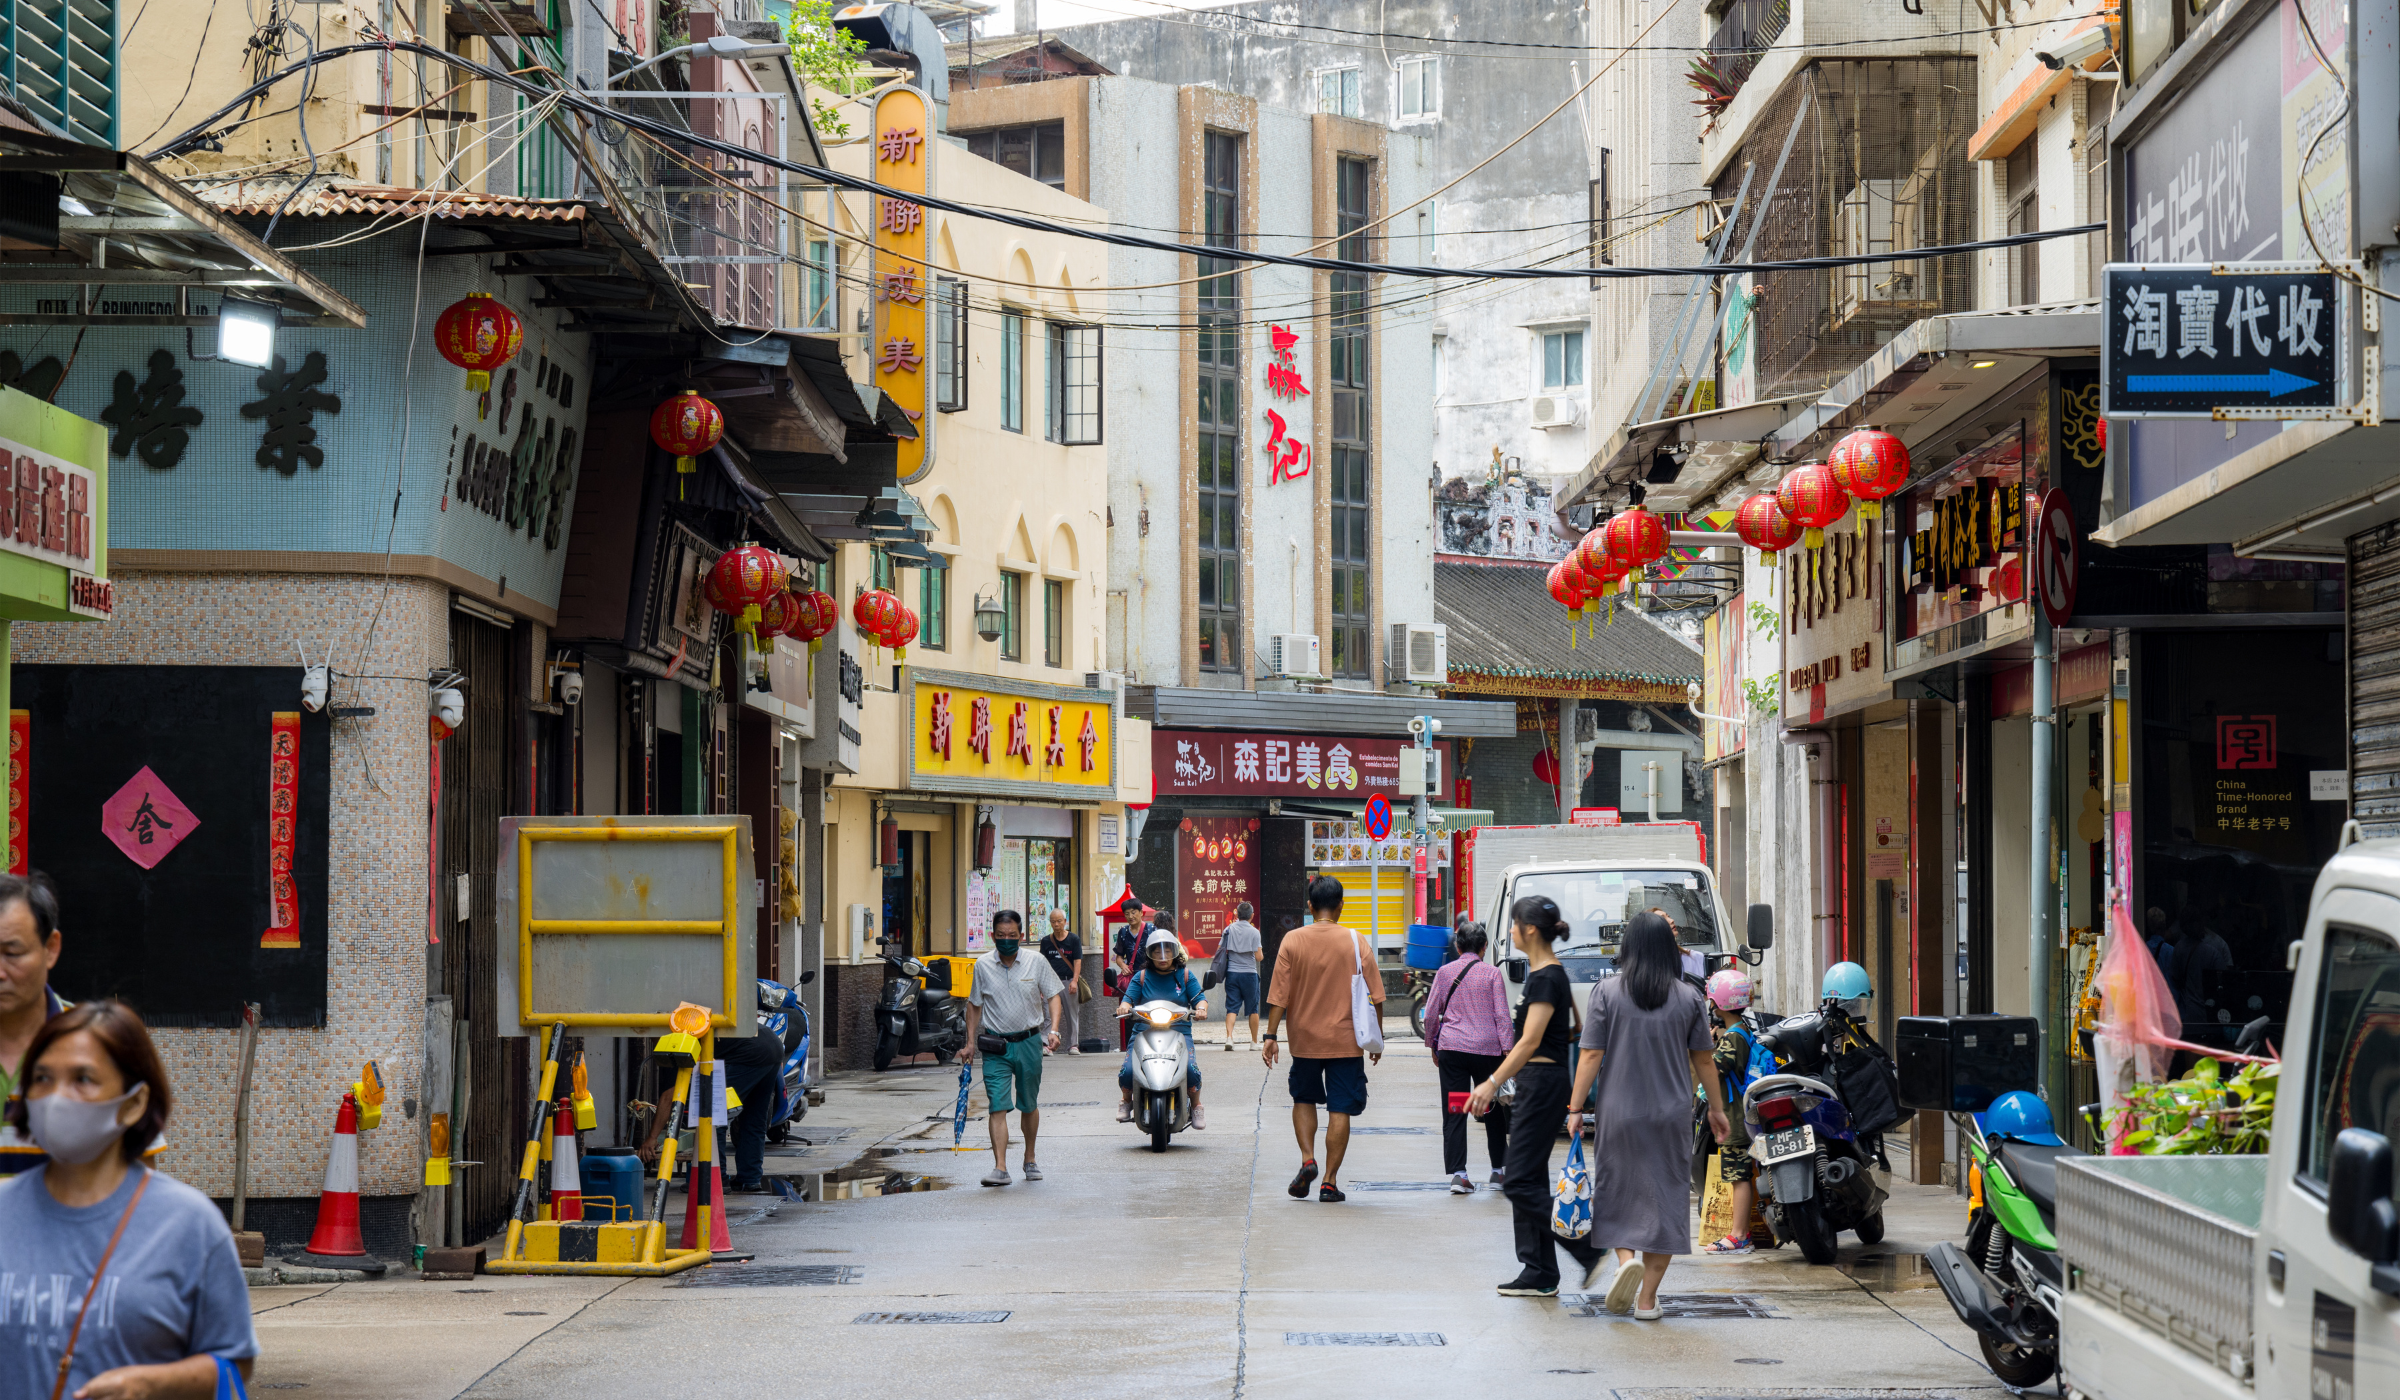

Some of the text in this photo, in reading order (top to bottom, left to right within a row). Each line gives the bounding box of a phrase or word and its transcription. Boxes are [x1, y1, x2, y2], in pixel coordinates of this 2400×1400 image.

[878, 126, 923, 437] 新聯成美
[2122, 284, 2324, 359] 淘寶代收
[1802, 475, 1819, 515] 一帆風順
[929, 691, 1100, 772] 新聯成美食
[1234, 739, 1353, 785] 森記美食
[1364, 775, 1399, 786] 外賣熱線:685
[2216, 780, 2246, 789] China
[2216, 792, 2292, 801] Time-Honored
[2216, 804, 2248, 814] Brand
[2217, 817, 2291, 831] 中华老字号
[1196, 839, 1245, 859] 2022
[1192, 879, 1247, 894] 春節快樂
[1777, 1131, 1793, 1144] MF
[1771, 1139, 1803, 1155] 19-81
